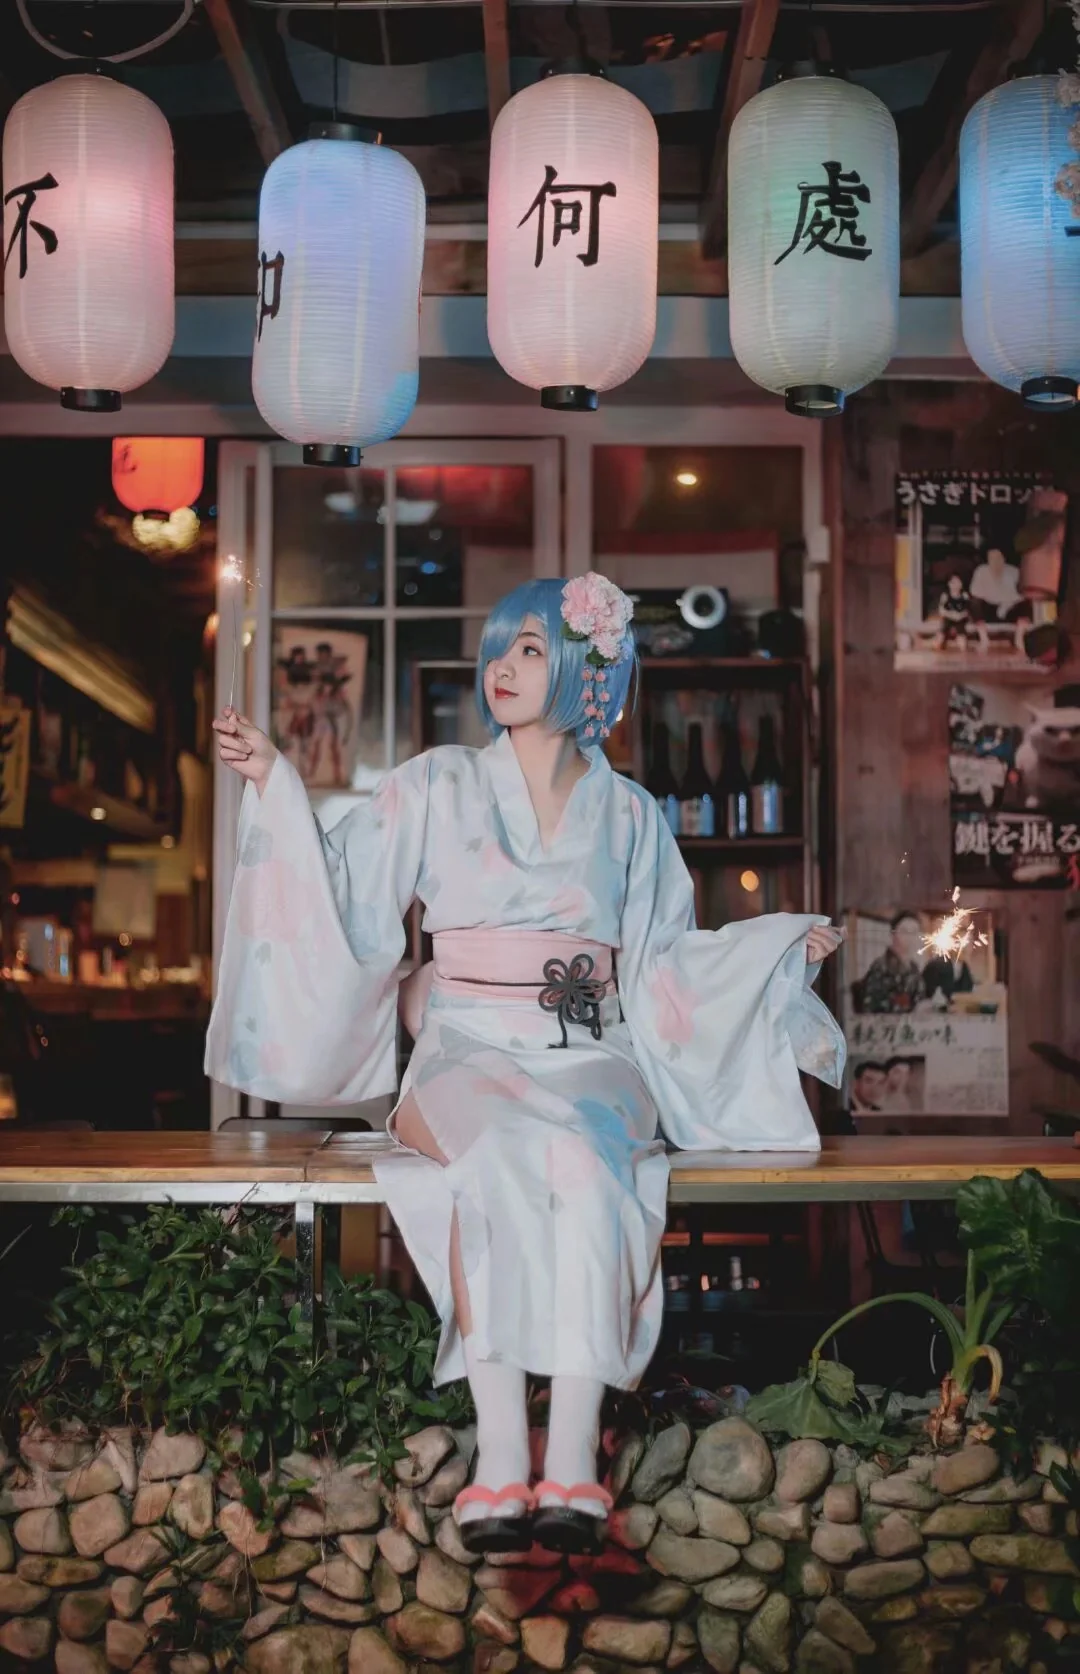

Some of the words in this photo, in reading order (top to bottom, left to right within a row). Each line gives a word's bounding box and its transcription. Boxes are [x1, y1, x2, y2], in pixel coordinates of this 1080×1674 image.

[4, 172, 59, 279] 不
[517, 164, 617, 268] 何
[774, 160, 873, 265] 處
